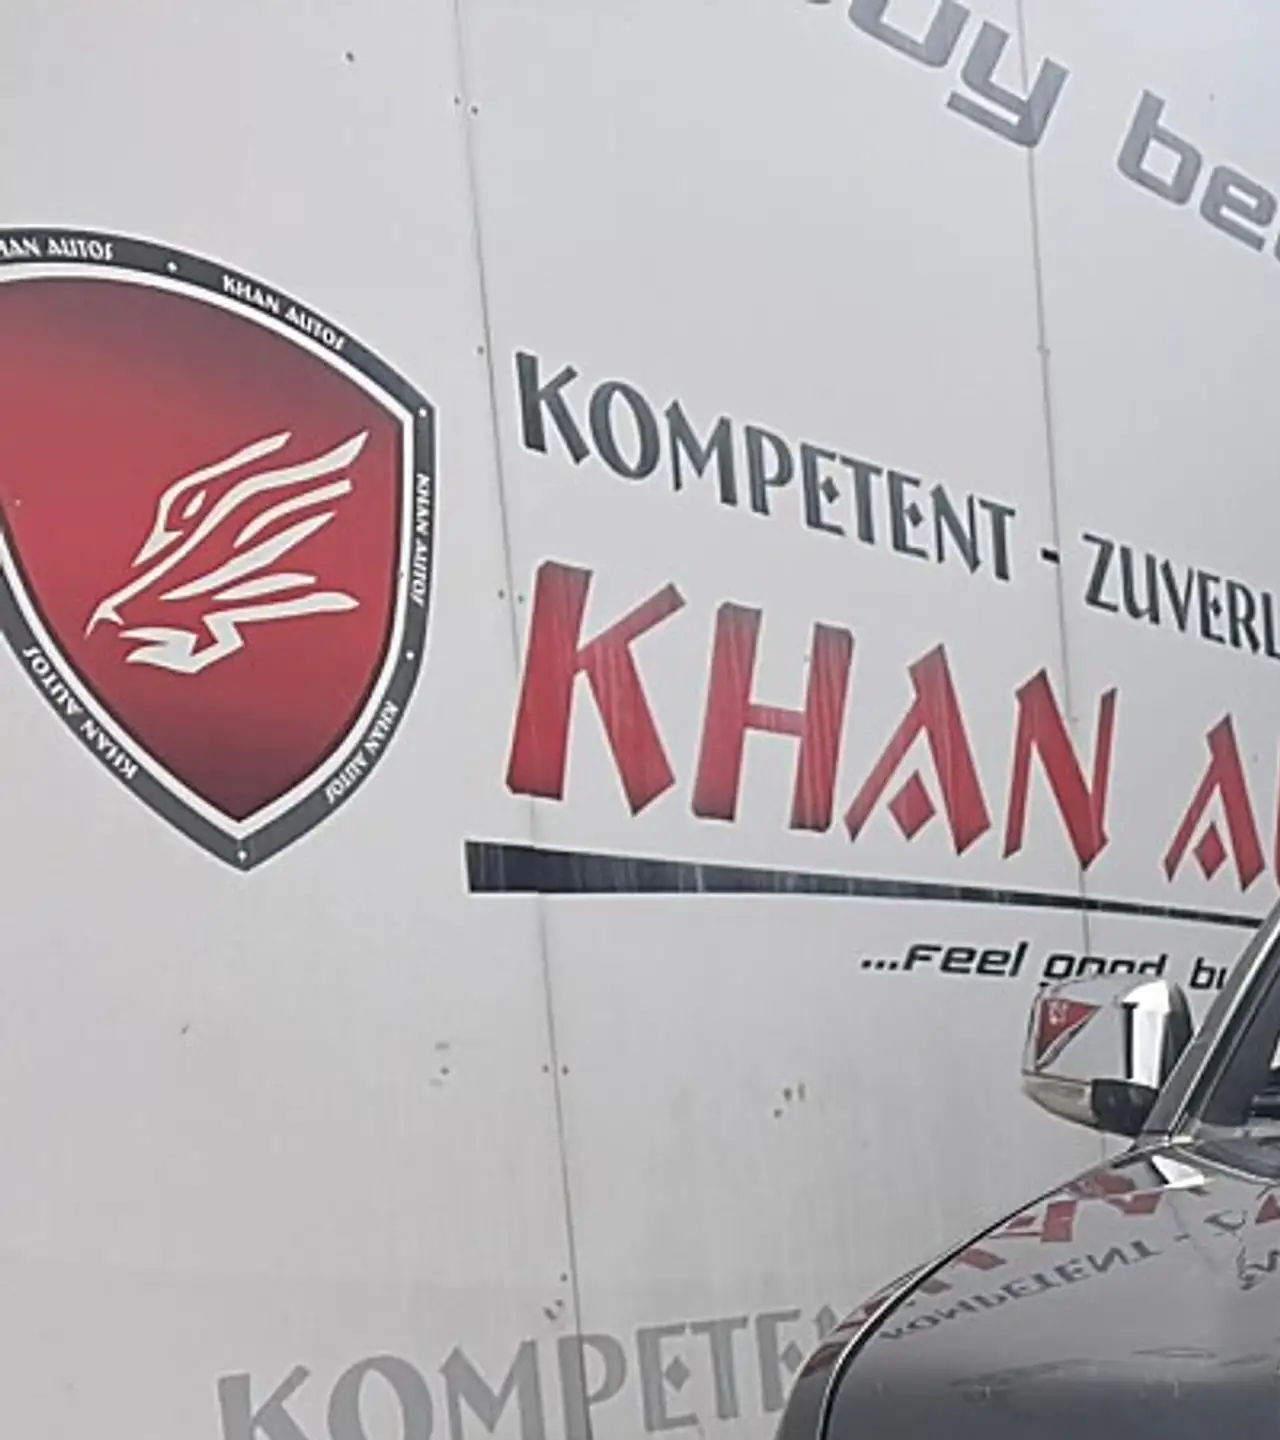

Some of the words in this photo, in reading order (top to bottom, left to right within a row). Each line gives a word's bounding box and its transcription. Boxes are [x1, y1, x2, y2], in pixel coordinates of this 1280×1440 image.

[808, 0, 1070, 148] uy
[48, 237, 113, 261] AUTOS
[222, 274, 279, 313] KHAN
[284, 306, 345, 350] AUTOS
[515, 351, 1016, 581] KOMPETENT
[22, 646, 83, 715] AUTOS
[506, 559, 1117, 871] KHAN
[80, 719, 139, 779] KHAN
[363, 700, 400, 757] KHAN
